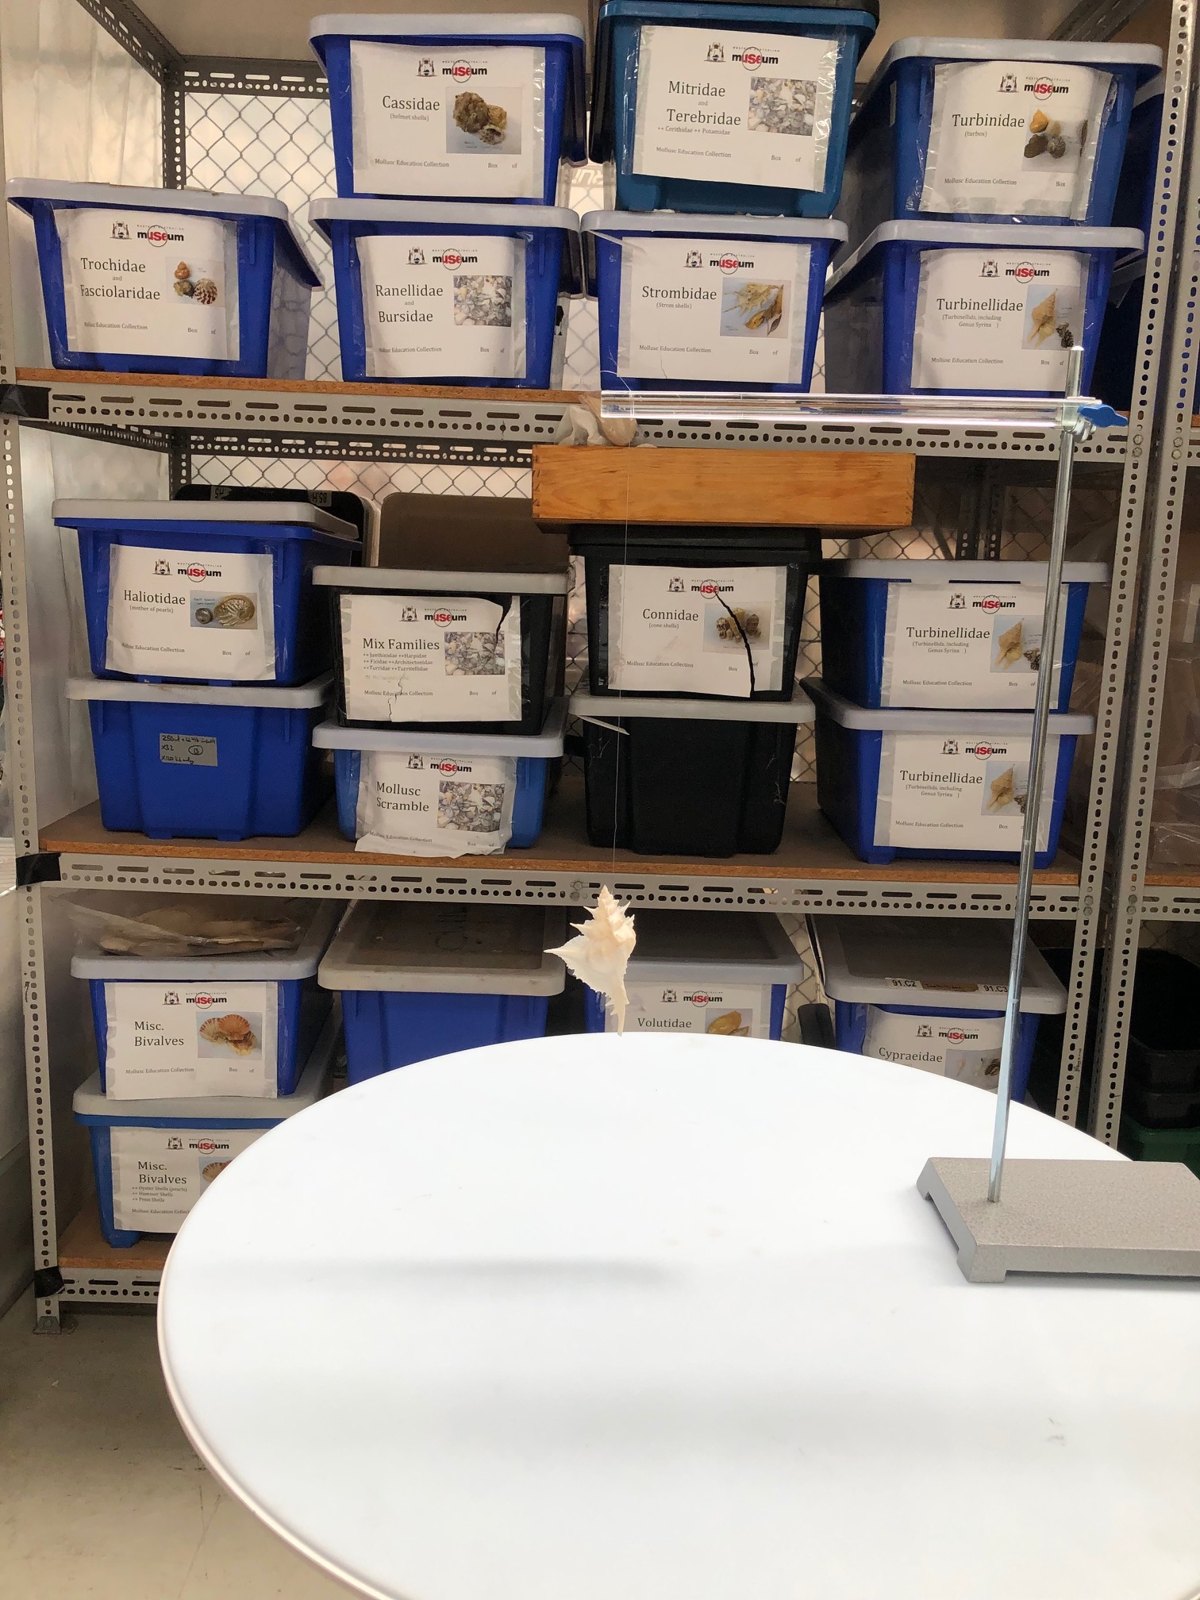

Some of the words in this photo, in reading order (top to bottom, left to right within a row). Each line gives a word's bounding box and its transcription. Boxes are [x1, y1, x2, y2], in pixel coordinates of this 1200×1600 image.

[668, 80, 726, 97] Mitridae
[382, 96, 441, 111] Cassidae
[667, 109, 741, 126] Terebridae
[952, 113, 1025, 128] Turbinidae
[81, 258, 146, 273] Trochidae
[80, 285, 161, 300] Fasciolaridae
[375, 285, 444, 297] Ranellidae
[642, 285, 717, 300] Strombidae
[937, 298, 1023, 311] Turbinellidae
[378, 310, 433, 322] Bursidae
[124, 590, 186, 605] Haliotidae
[642, 608, 699, 621] Connidae
[906, 627, 990, 639] Turbinellidae
[363, 638, 384, 650] Mix
[388, 638, 440, 650] Families
[900, 770, 983, 784] Turbinellidae
[376, 781, 421, 796] Mollusc
[376, 797, 430, 812] Scramble
[892, 979, 917, 988] 91.C2
[984, 984, 1008, 993] 91.C3
[134, 1021, 164, 1031] Misc.
[638, 1017, 692, 1028] Volutidae
[134, 1036, 184, 1047] Bivalves
[879, 1047, 943, 1063] Cypraeidae
[138, 1161, 167, 1171] Misc.
[139, 1174, 187, 1184] Bivalves
